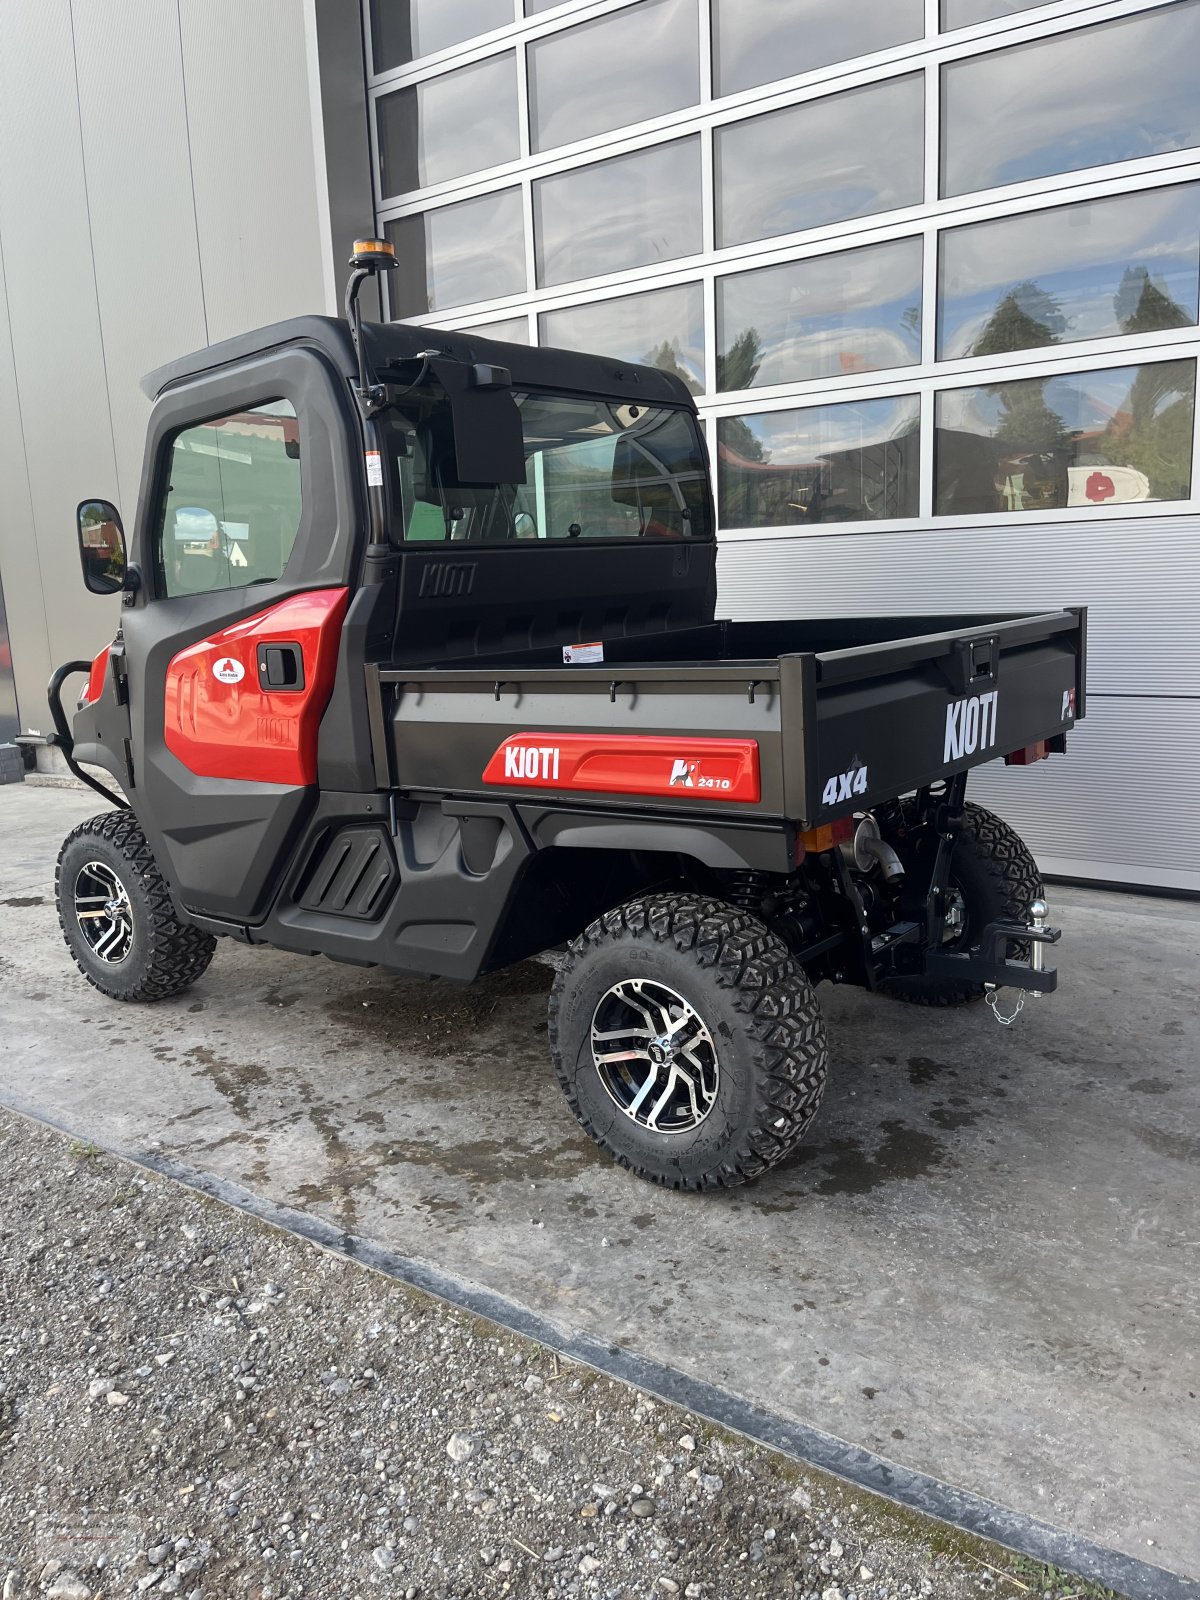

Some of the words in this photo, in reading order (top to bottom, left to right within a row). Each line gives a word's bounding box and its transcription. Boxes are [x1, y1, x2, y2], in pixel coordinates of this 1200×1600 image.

[419, 562, 478, 597] KIOTI
[944, 690, 998, 764] KIOTI
[505, 746, 560, 780] KIOTI
[698, 778, 730, 789] 2410
